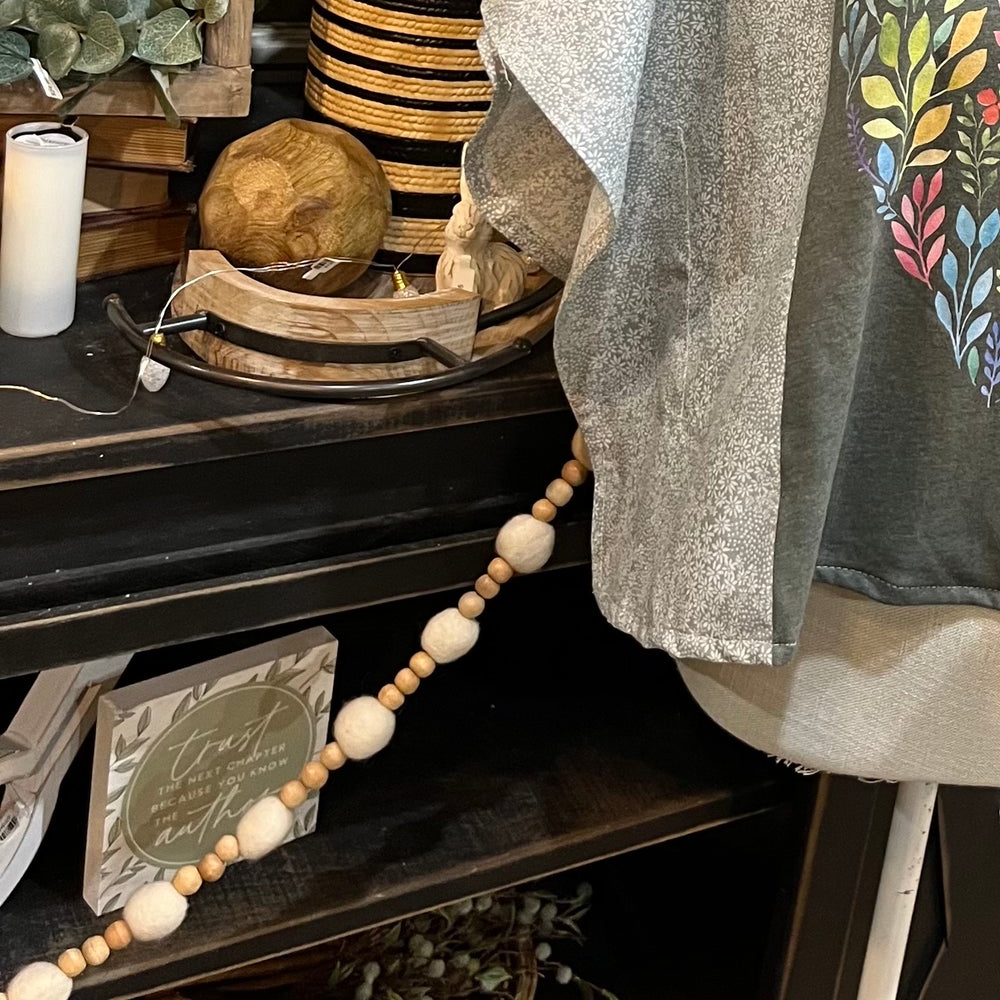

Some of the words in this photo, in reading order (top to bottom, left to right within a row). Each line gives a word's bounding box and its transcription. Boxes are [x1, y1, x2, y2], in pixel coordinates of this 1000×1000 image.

[158, 780, 183, 796] THE
[187, 765, 222, 785] NEXT
[226, 742, 287, 771] CHAPTER
[168, 700, 289, 782] trust
[151, 783, 213, 814] BECAUSE
[218, 772, 246, 788] YOU
[250, 757, 290, 778] KNOW
[154, 783, 283, 847] auth
[155, 811, 178, 827] THE
